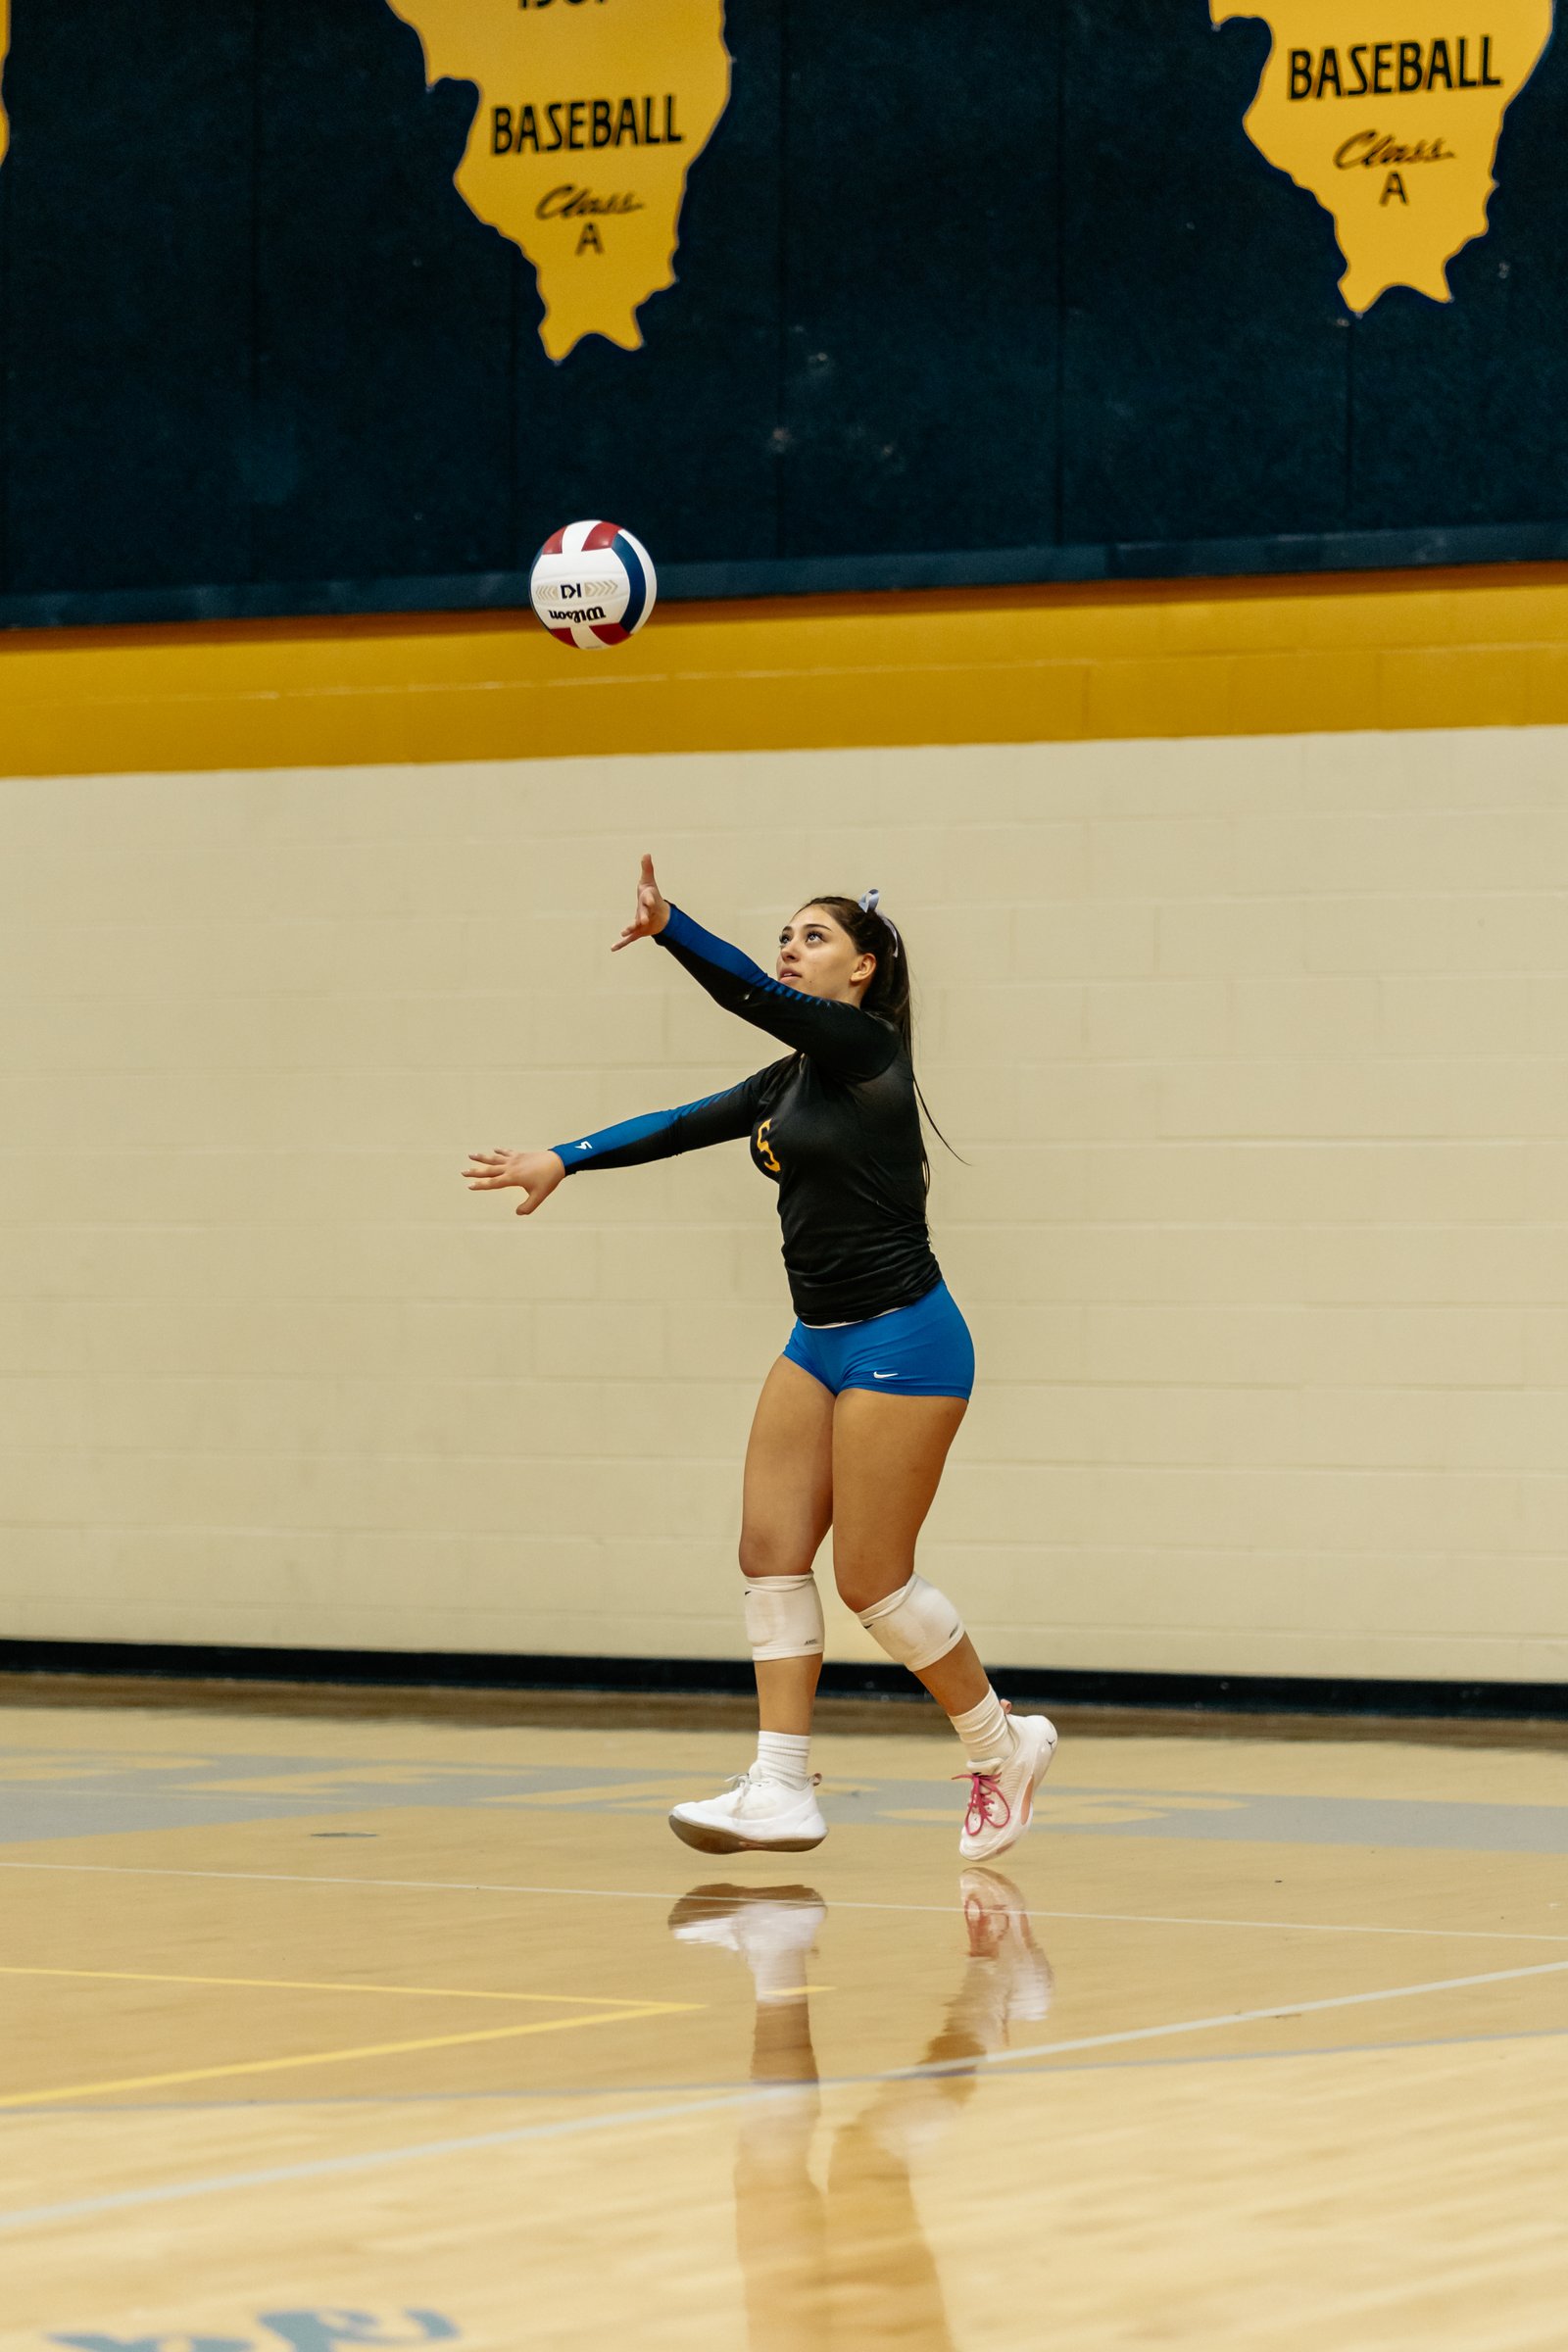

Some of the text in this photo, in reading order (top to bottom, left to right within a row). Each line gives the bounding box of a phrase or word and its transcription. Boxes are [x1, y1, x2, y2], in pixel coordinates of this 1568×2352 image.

[1289, 35, 1502, 100] BASEBALL
[493, 95, 683, 155] BASEBALL
[1333, 129, 1455, 170] Class
[535, 184, 645, 220] Class
[1379, 172, 1409, 206] A
[576, 222, 605, 255] A
[548, 606, 607, 623] Wilson
[757, 1117, 781, 1172] 5
